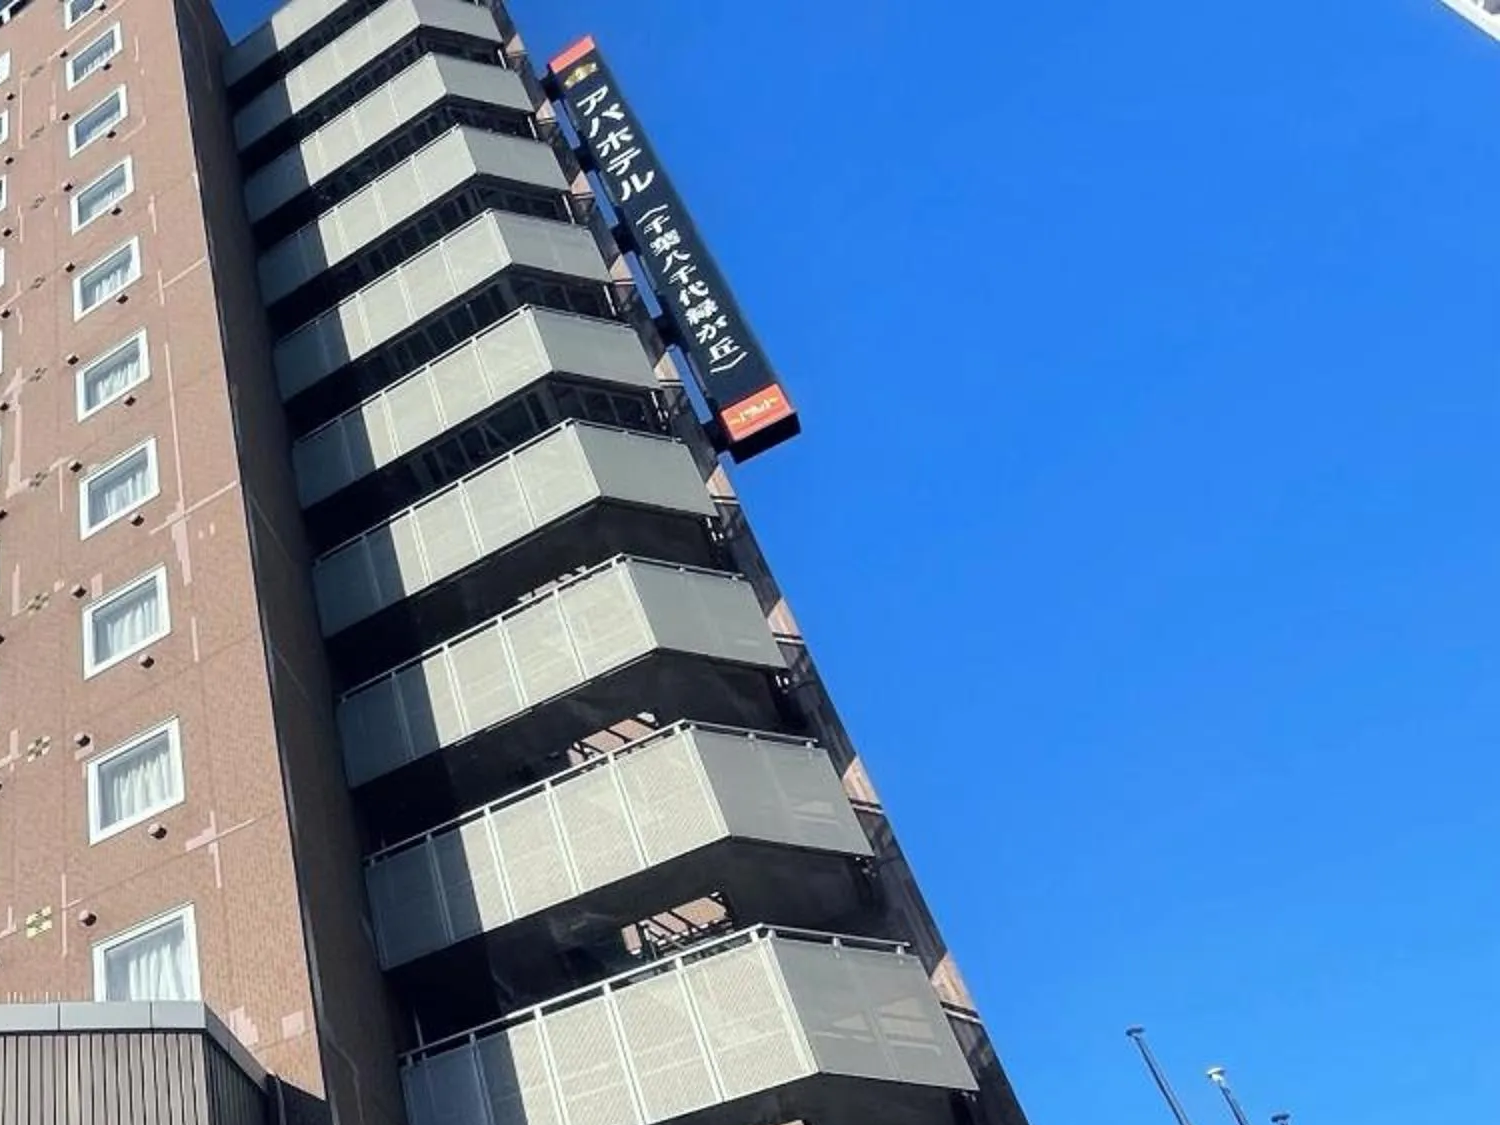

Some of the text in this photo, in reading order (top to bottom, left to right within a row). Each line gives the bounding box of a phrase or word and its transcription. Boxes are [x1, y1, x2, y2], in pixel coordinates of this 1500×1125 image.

[576, 85, 655, 201] アパホテル
